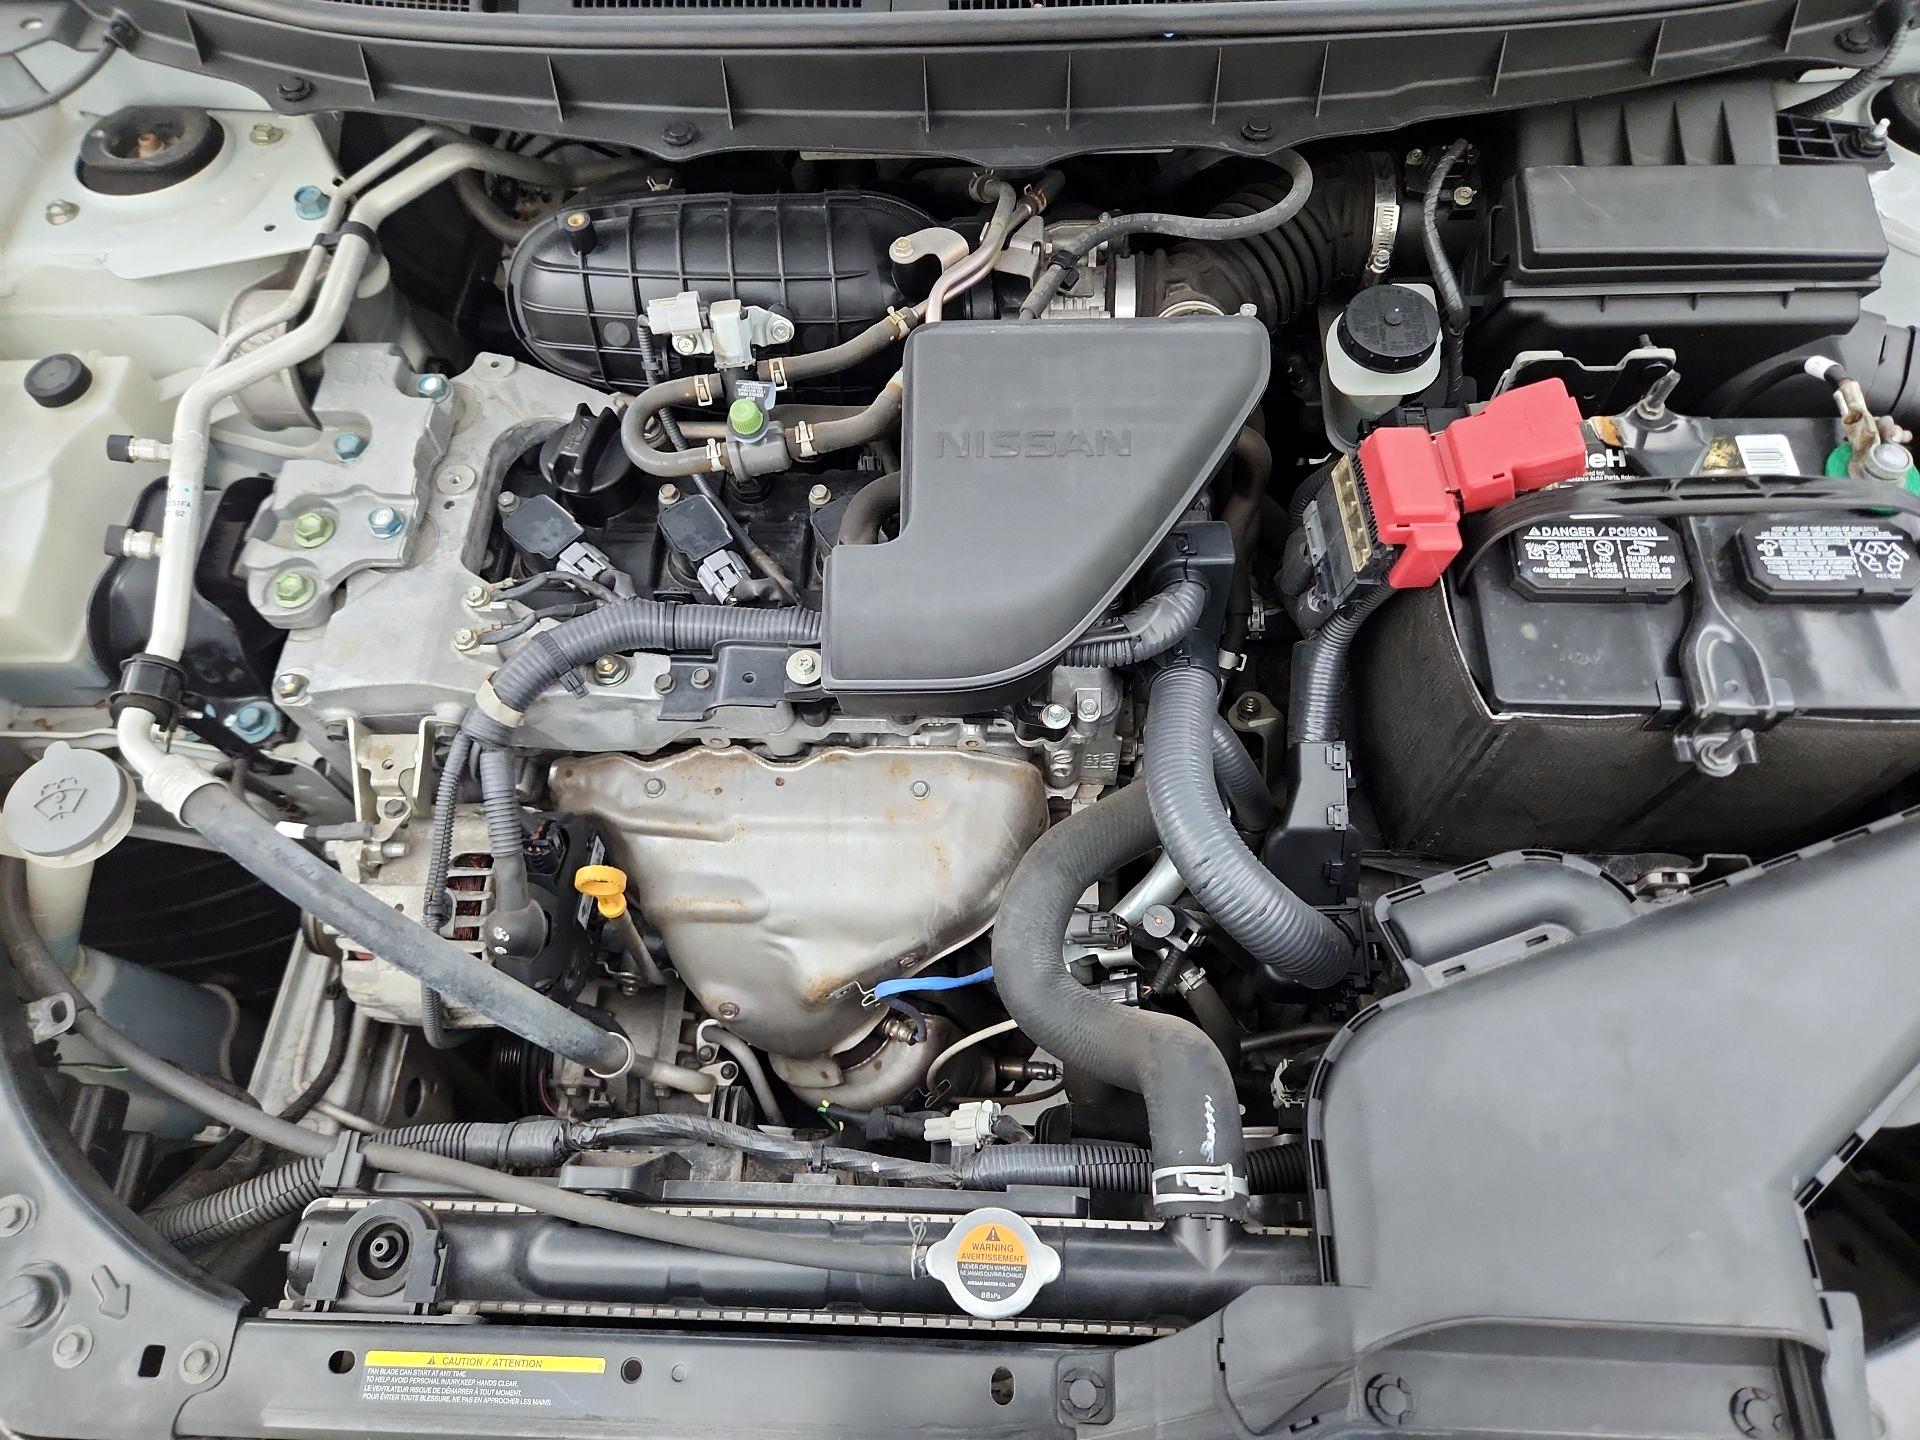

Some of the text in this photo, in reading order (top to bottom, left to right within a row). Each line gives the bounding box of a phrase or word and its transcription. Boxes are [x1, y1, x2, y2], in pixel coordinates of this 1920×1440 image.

[936, 430, 1131, 458] NISSAN
[1542, 527, 1657, 537] DANGER / POISON
[1560, 542, 1583, 550] SHIELD
[972, 1243, 1014, 1252] WARNING
[961, 1252, 1024, 1262] AVERTISSEMENT
[442, 1357, 482, 1367] CAUTION
[492, 1358, 543, 1368] ATTENTION
[367, 1367, 378, 1375] FAN
[400, 1368, 413, 1376] CAN
[409, 1377, 439, 1385] PERSONAL
[372, 1385, 409, 1393] VENTILATEUR
[410, 1386, 432, 1394] RISQUE
[441, 1386, 473, 1395] DÉMARRER
[480, 1388, 495, 1396] TOUT
[362, 1392, 379, 1400] POUR
[380, 1392, 399, 1400] ÉVITER
[400, 1393, 419, 1401] TOUTE
[482, 1397, 520, 1405] APPROCHER
